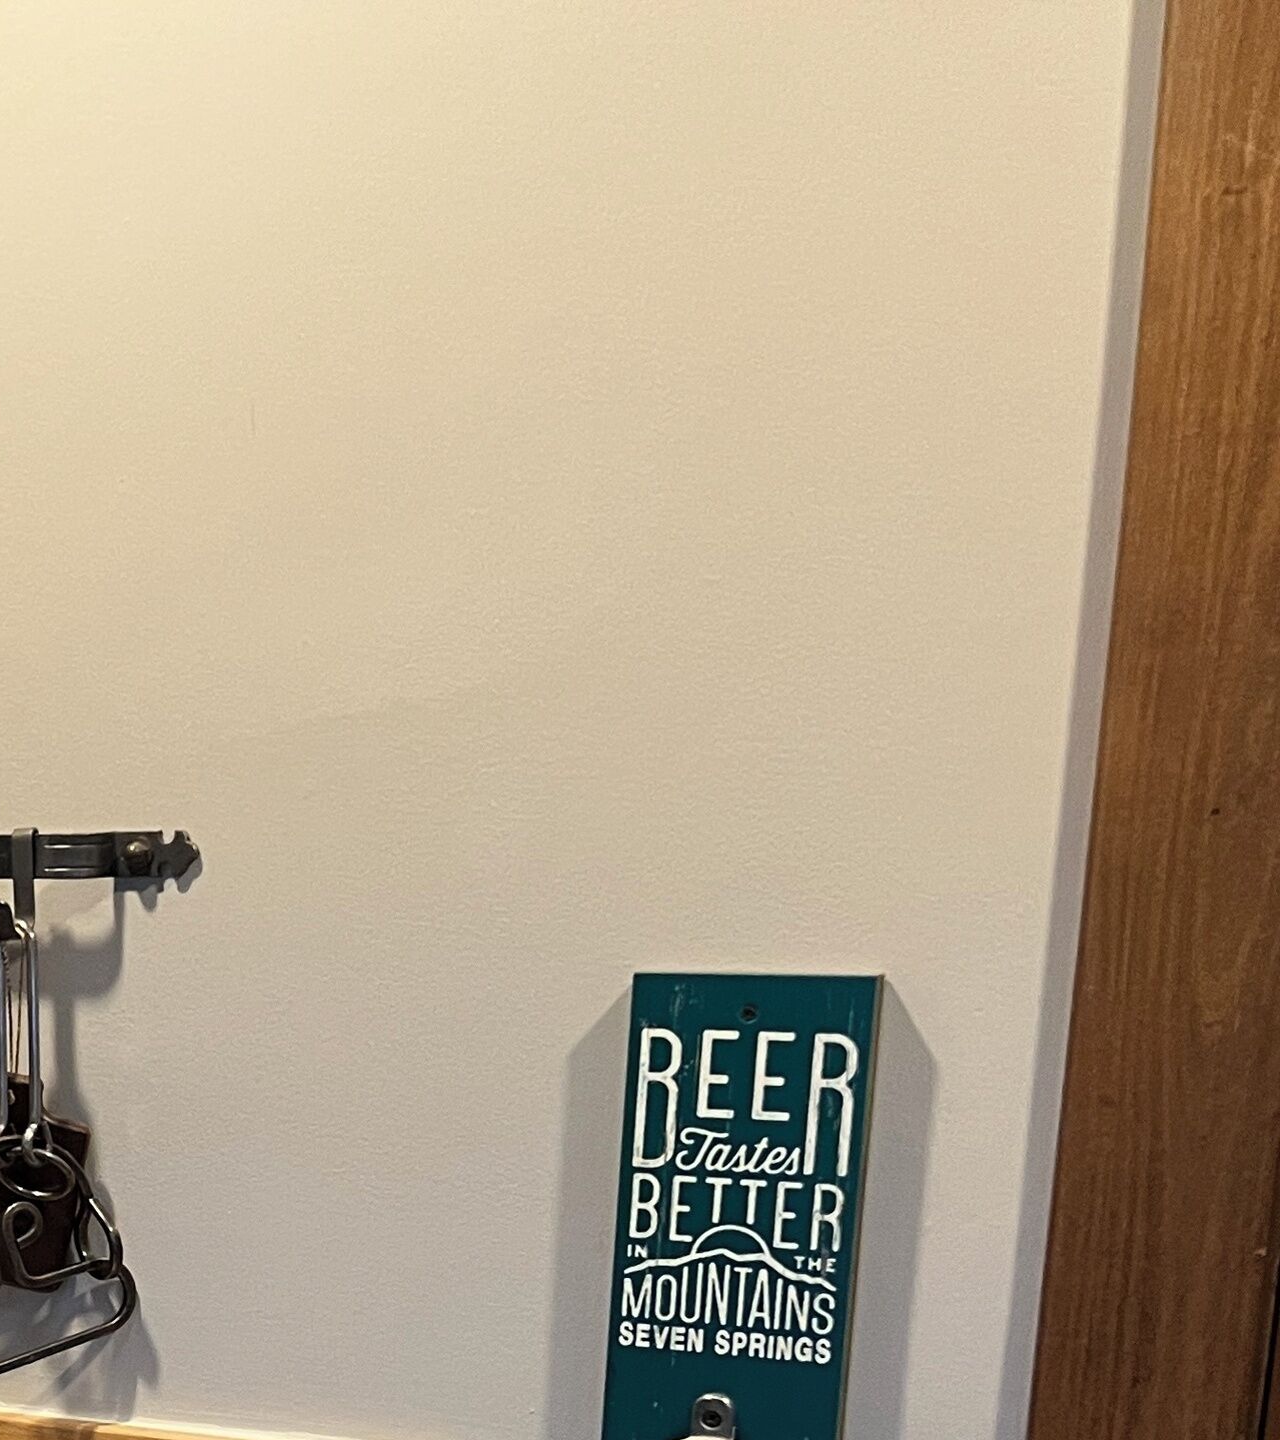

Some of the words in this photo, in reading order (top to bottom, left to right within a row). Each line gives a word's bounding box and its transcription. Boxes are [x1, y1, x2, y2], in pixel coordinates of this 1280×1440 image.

[631, 1027, 859, 1177] BEER
[675, 1126, 801, 1175] Tastes
[628, 1172, 845, 1252] BETTER
[626, 1243, 649, 1259] IN
[793, 1255, 837, 1273] THE
[621, 1262, 836, 1335] MOUNTAINS
[618, 1321, 704, 1353] SEVEN
[714, 1329, 832, 1364] SPRINGS
